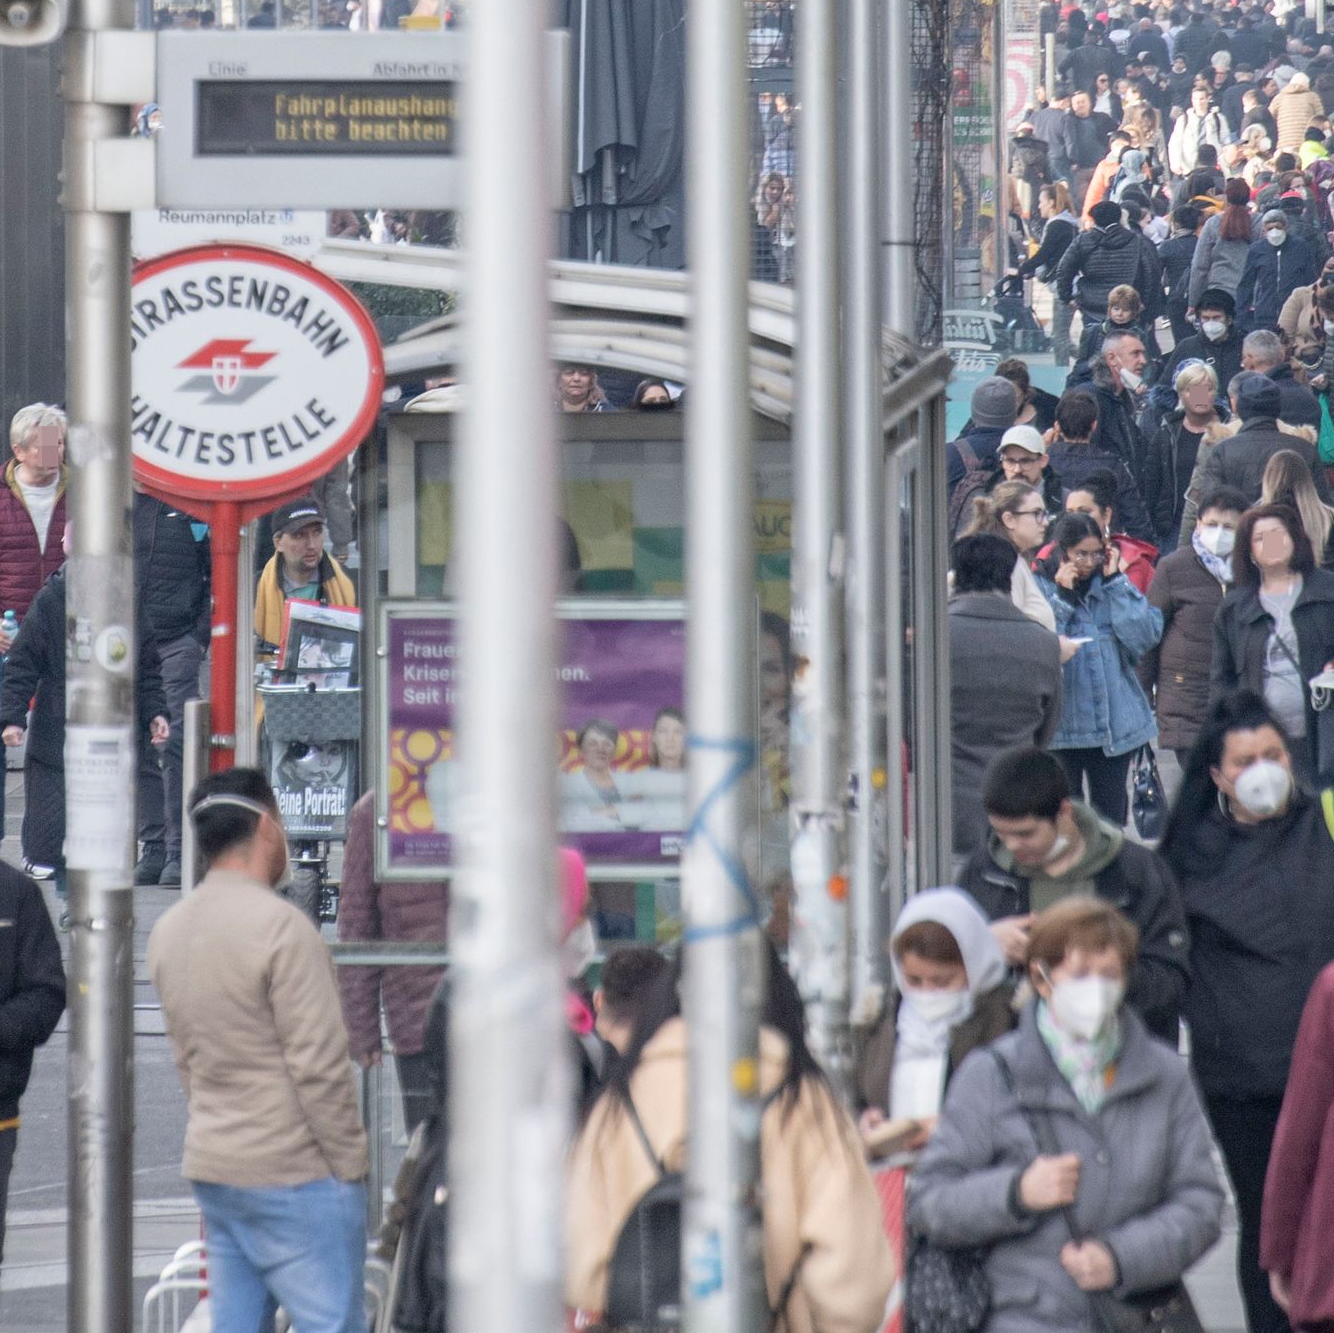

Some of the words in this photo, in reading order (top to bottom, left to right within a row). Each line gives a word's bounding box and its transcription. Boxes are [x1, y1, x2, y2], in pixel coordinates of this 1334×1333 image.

[276, 119, 338, 141] bitte
[349, 119, 447, 141] beachten
[158, 209, 276, 228] Reumannplatz
[403, 688, 439, 706] Seit
[304, 786, 346, 816] Porträt!
